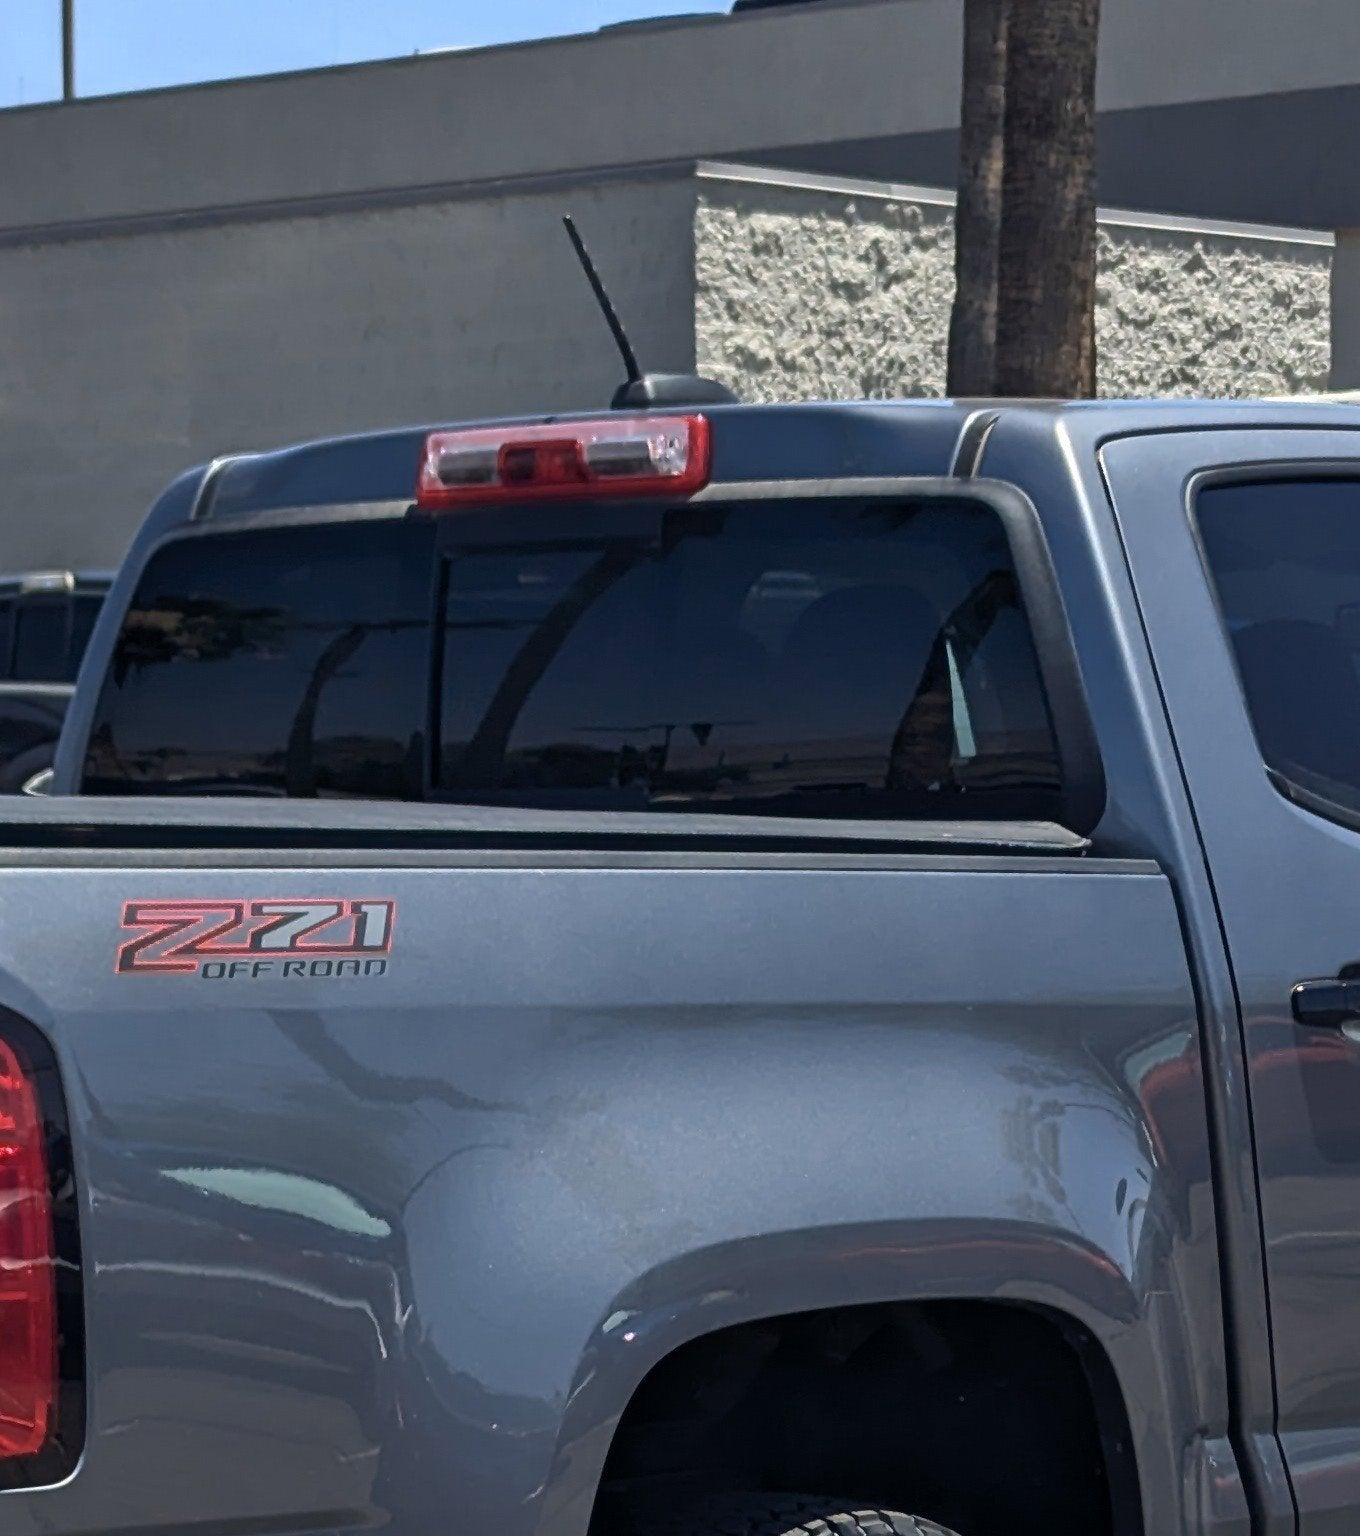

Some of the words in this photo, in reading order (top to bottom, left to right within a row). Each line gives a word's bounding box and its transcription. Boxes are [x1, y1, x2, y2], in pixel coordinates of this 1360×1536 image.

[114, 898, 396, 975] Z71
[201, 961, 275, 979] OFF
[282, 958, 388, 978] ROAD
